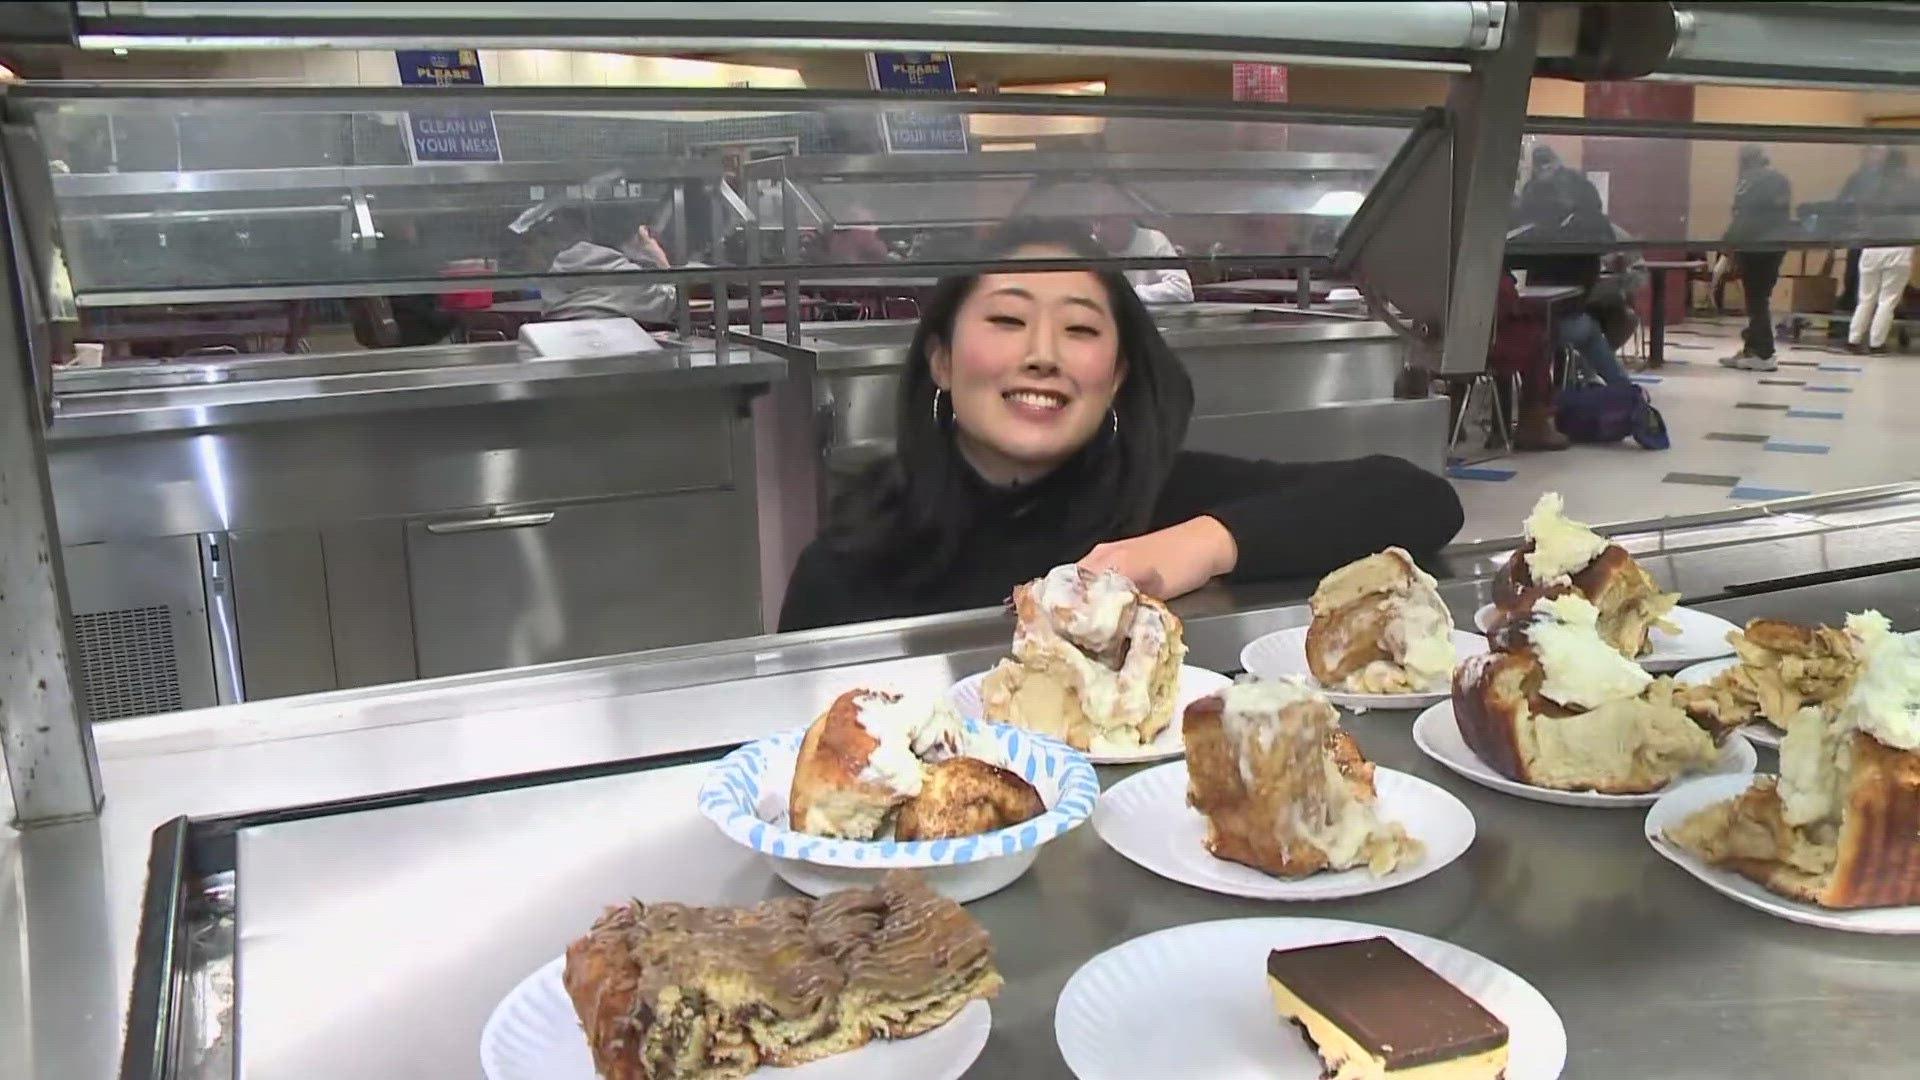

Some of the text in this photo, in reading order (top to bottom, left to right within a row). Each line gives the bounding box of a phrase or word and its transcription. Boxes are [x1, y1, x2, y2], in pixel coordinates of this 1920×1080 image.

[418, 67, 471, 79] PLEASE
[892, 64, 940, 74] PLEASE
[908, 73, 925, 84] BE
[420, 119, 488, 134] CLEAN UP
[416, 138, 497, 153] YOUR MESS
